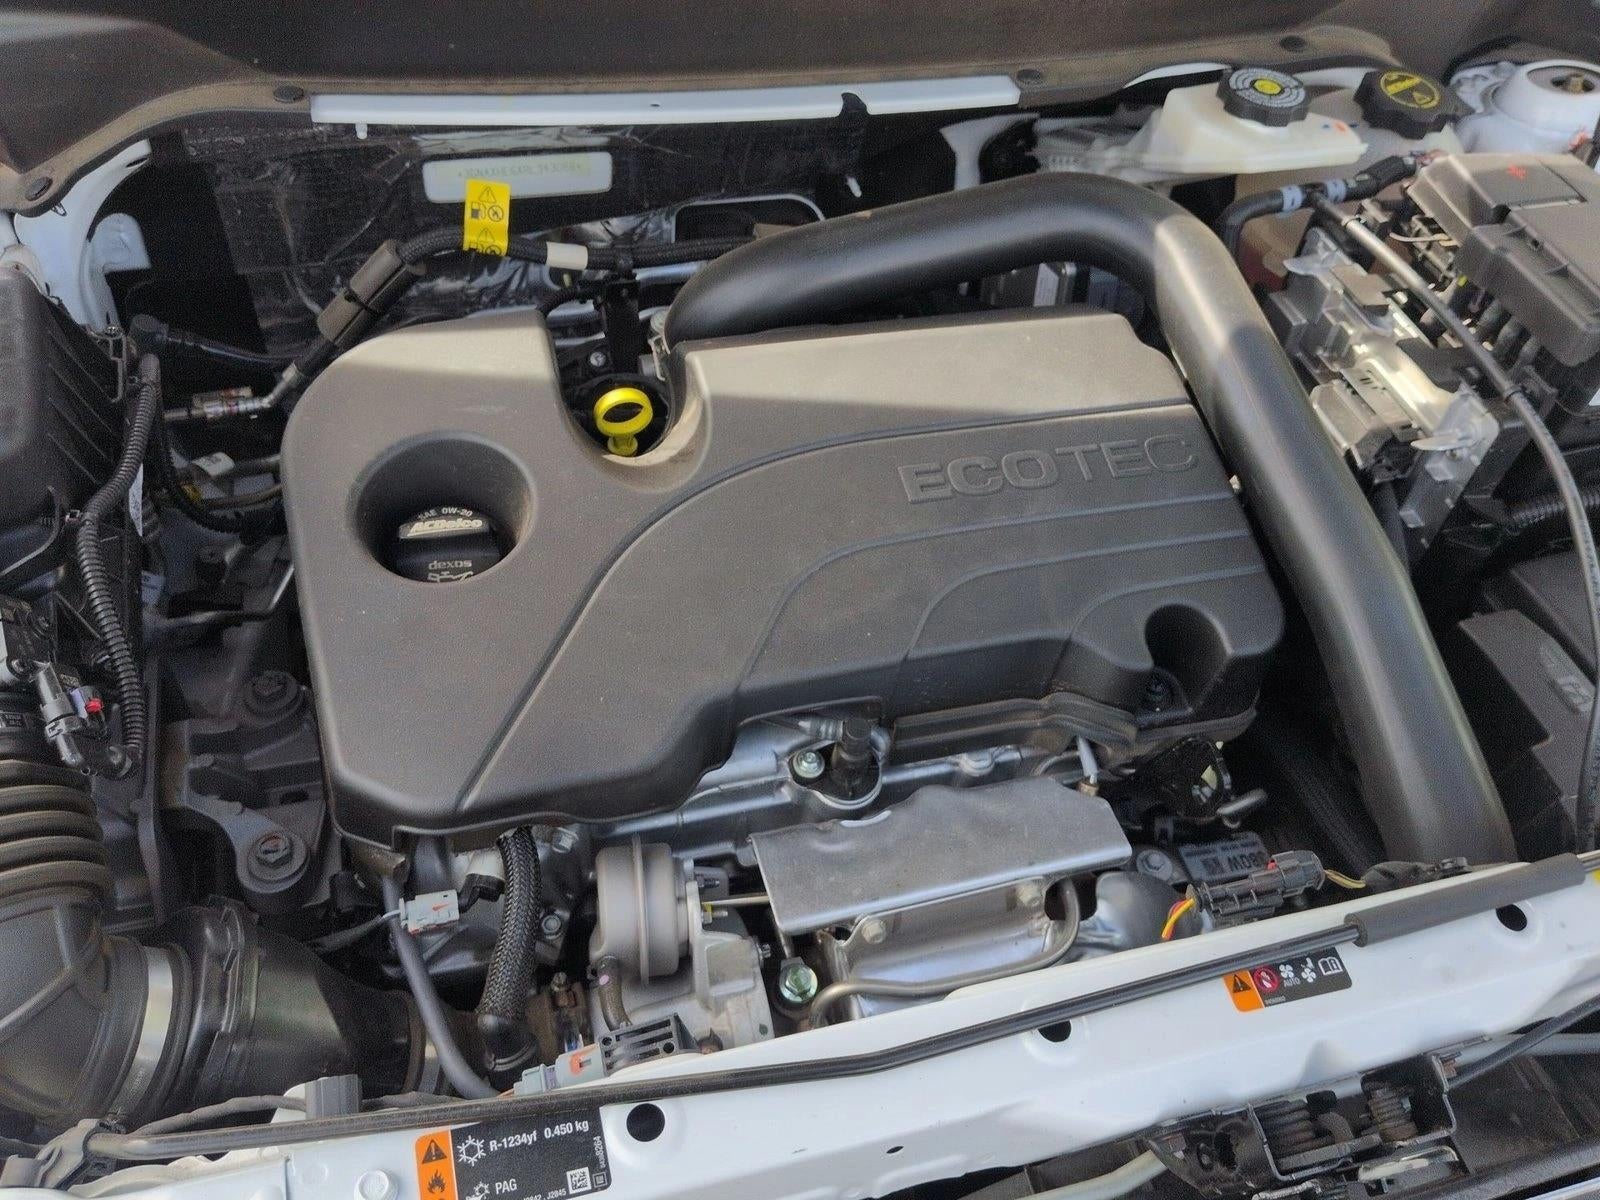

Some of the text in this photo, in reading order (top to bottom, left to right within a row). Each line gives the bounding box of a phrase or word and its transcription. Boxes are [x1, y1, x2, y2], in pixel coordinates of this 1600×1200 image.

[897, 434, 1196, 503] ECOTEC
[428, 560, 472, 570] dexos
[489, 1120, 589, 1151] R-1234yf 0.450 kg
[495, 1178, 517, 1195] PAG
